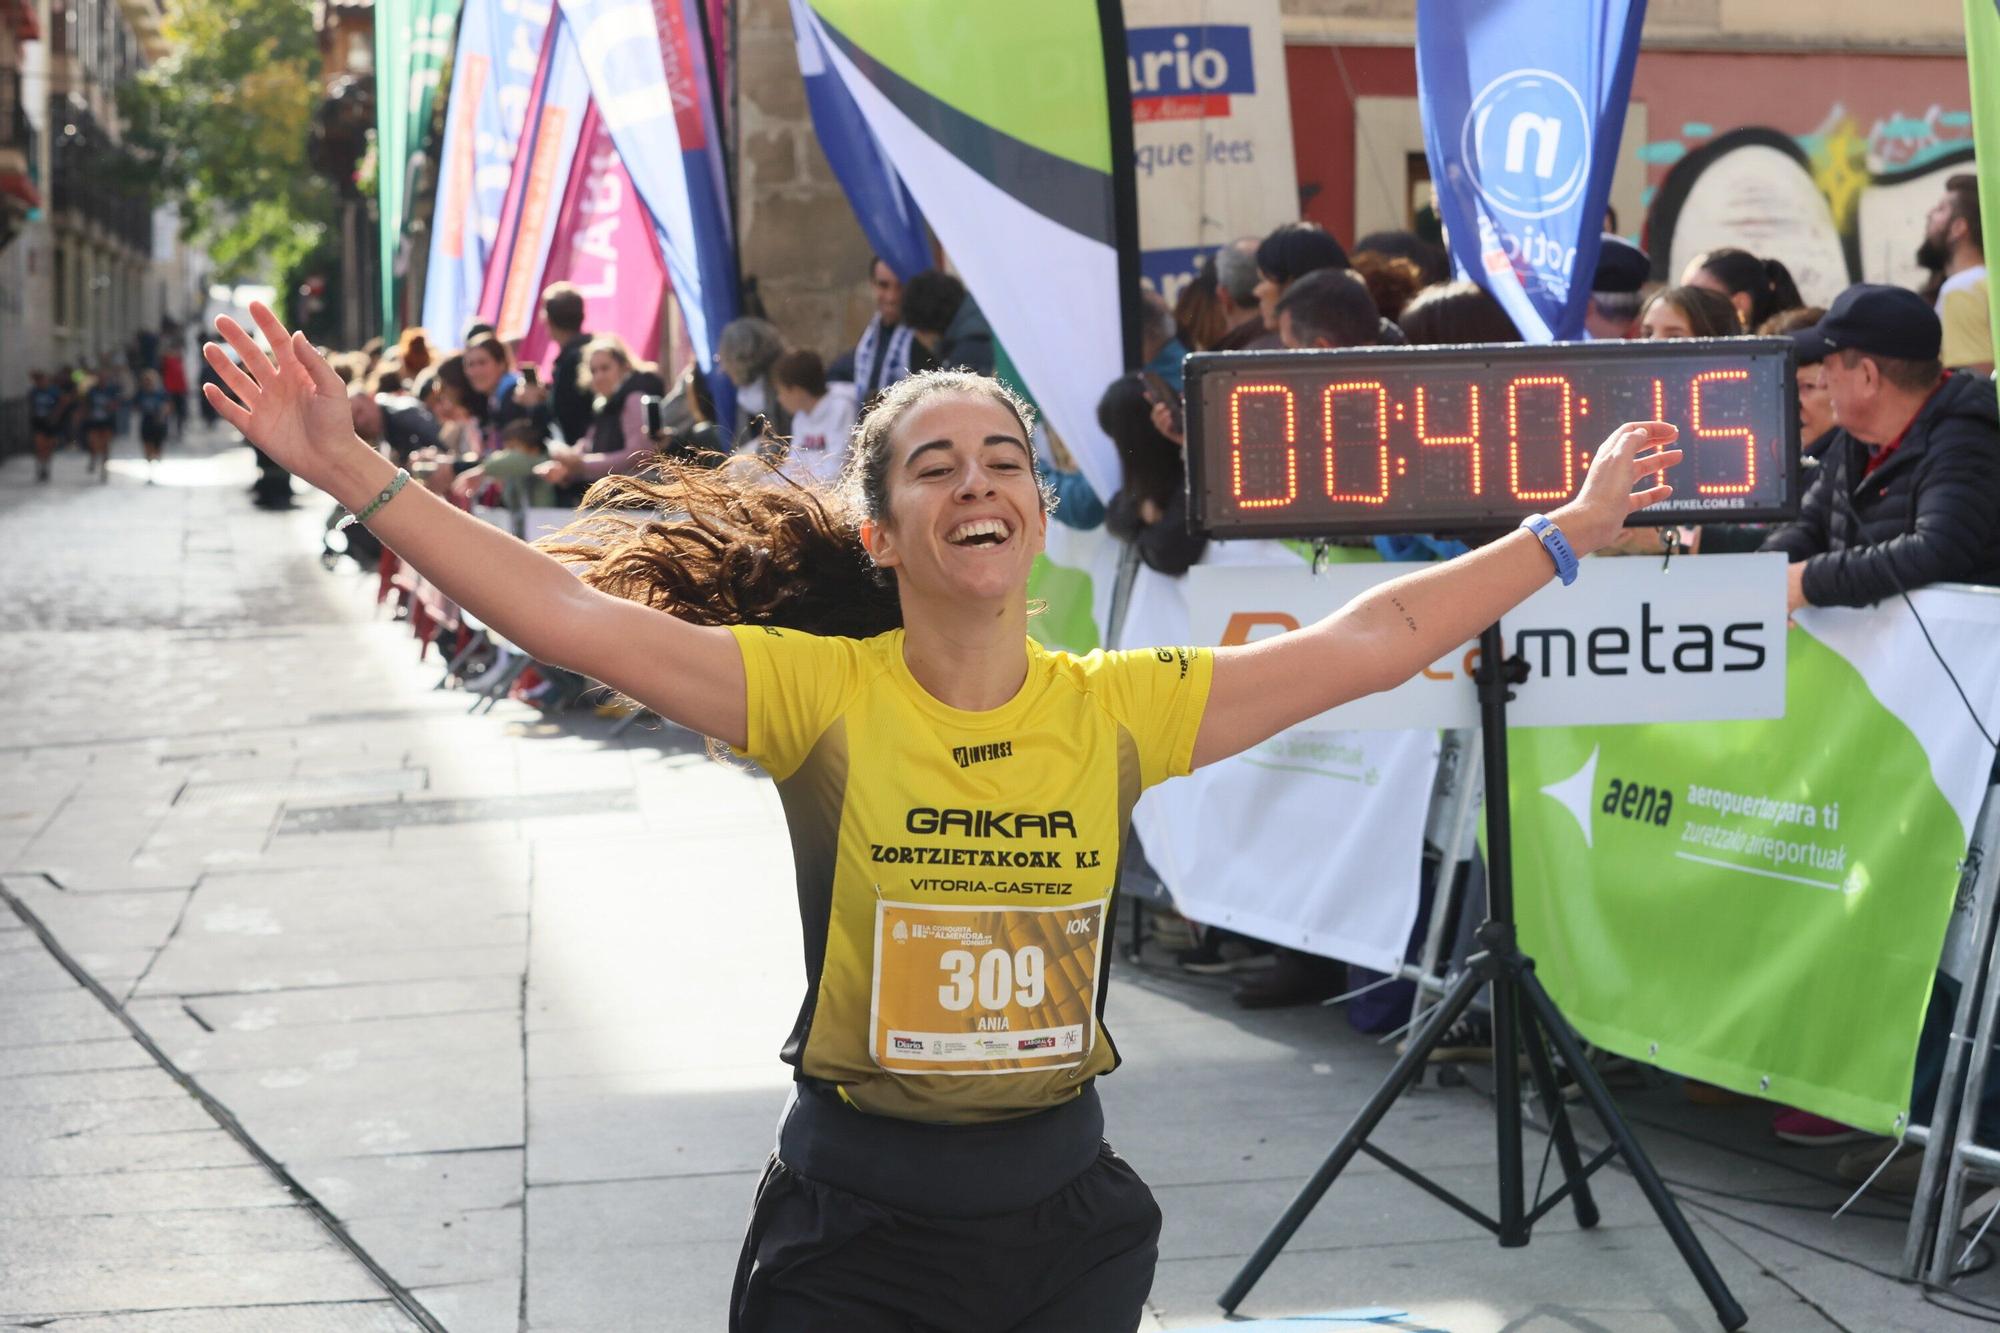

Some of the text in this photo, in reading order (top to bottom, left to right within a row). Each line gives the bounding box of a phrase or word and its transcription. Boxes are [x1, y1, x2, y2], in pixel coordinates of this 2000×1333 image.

[1135, 132, 1254, 176] que lees
[969, 741, 1013, 764] INVERSE
[1602, 778, 1673, 826] aena
[1823, 802, 1839, 830] ti
[906, 807, 1077, 838] GAIKAR
[871, 845, 1062, 868] ZORTZIETAKOAK
[910, 879, 1073, 895] VITORIA-GASTEIZ
[938, 946, 1045, 1012] 309
[977, 1016, 1010, 1031] ANIA
